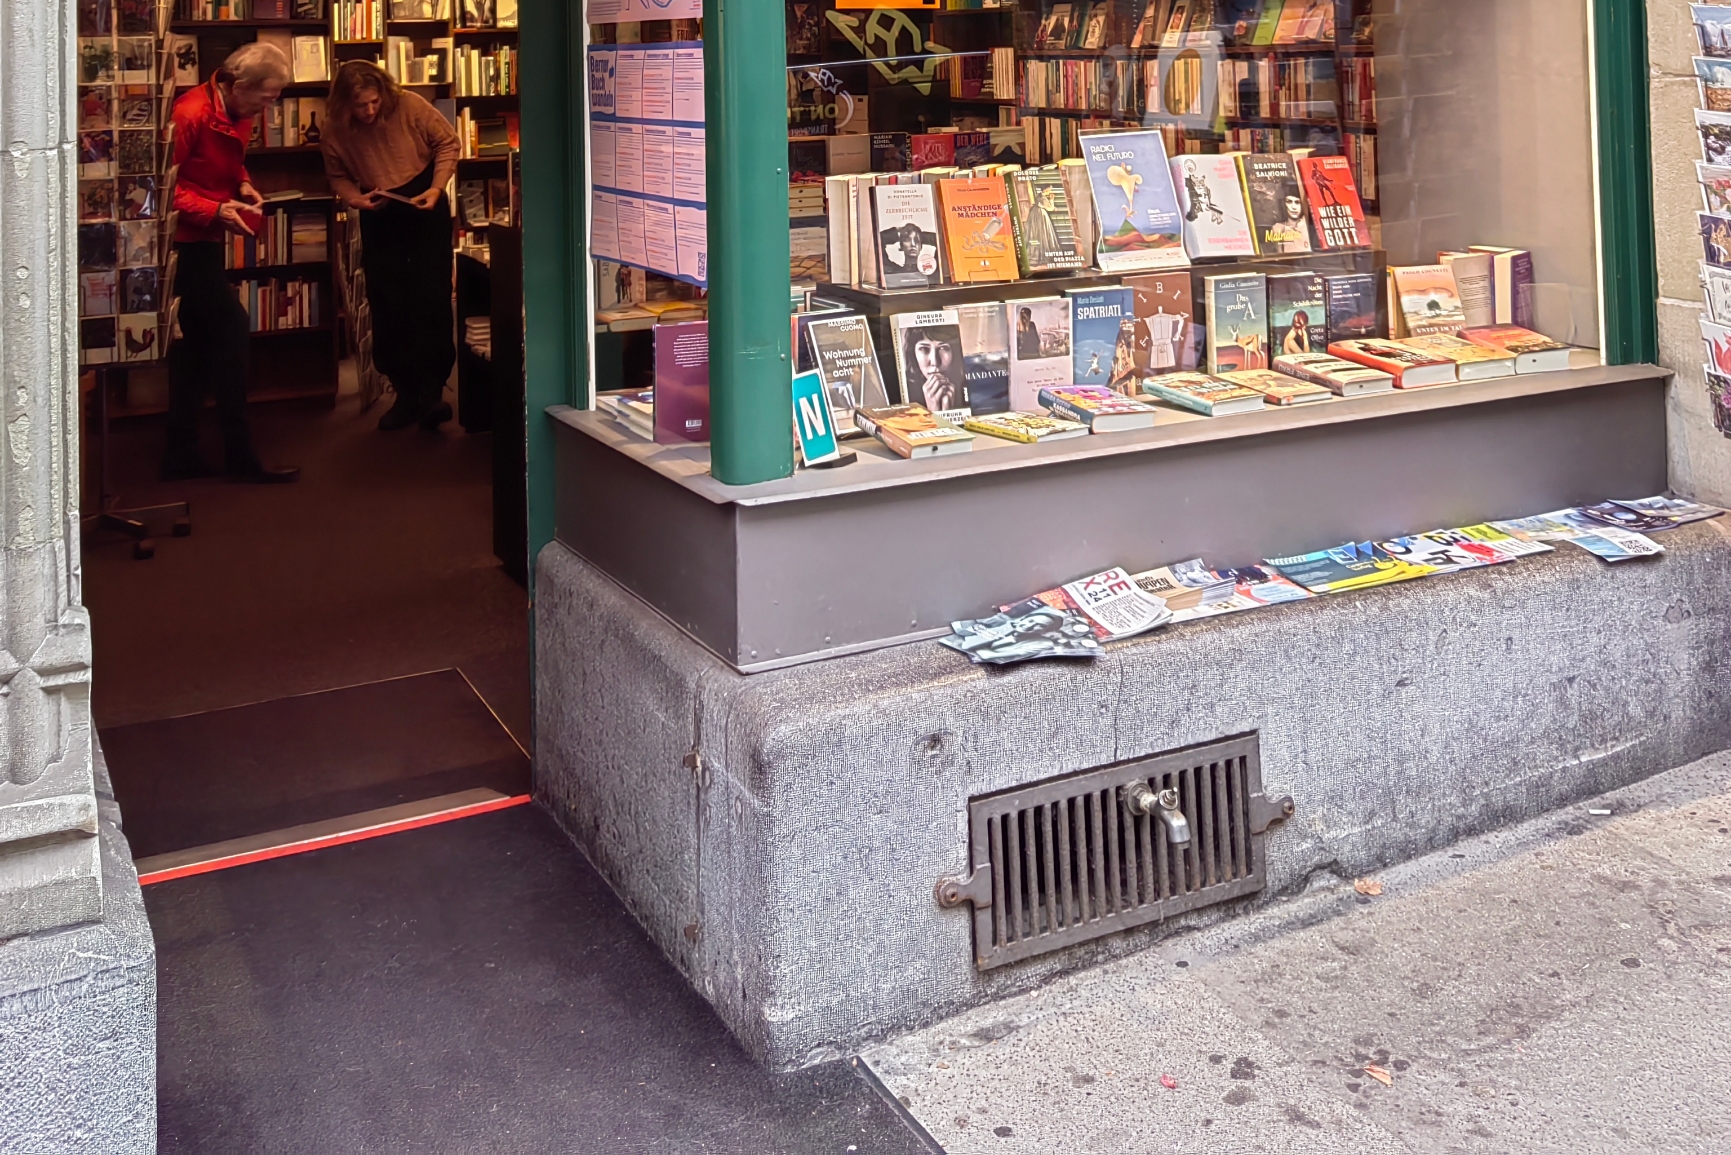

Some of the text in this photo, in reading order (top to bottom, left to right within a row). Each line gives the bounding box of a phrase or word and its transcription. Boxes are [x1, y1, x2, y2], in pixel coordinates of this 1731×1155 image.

[1093, 151, 1134, 161] NEL FUTURO
[1253, 162, 1287, 170] BEATRICE
[1256, 170, 1287, 178] SALVIONI
[951, 204, 1002, 213] ANSTÄNDIGE
[1318, 205, 1352, 218] WIE EIN
[957, 210, 998, 219] MÄDCHEN
[1321, 216, 1355, 228] WILDER
[1324, 228, 1360, 246] GOTT
[1077, 304, 1121, 320] SPATRIATI
[840, 324, 864, 332] CUOMO
[823, 348, 866, 360] Wohnung
[836, 355, 873, 367] Nummer
[833, 368, 854, 378] acht
[798, 393, 826, 441] N
